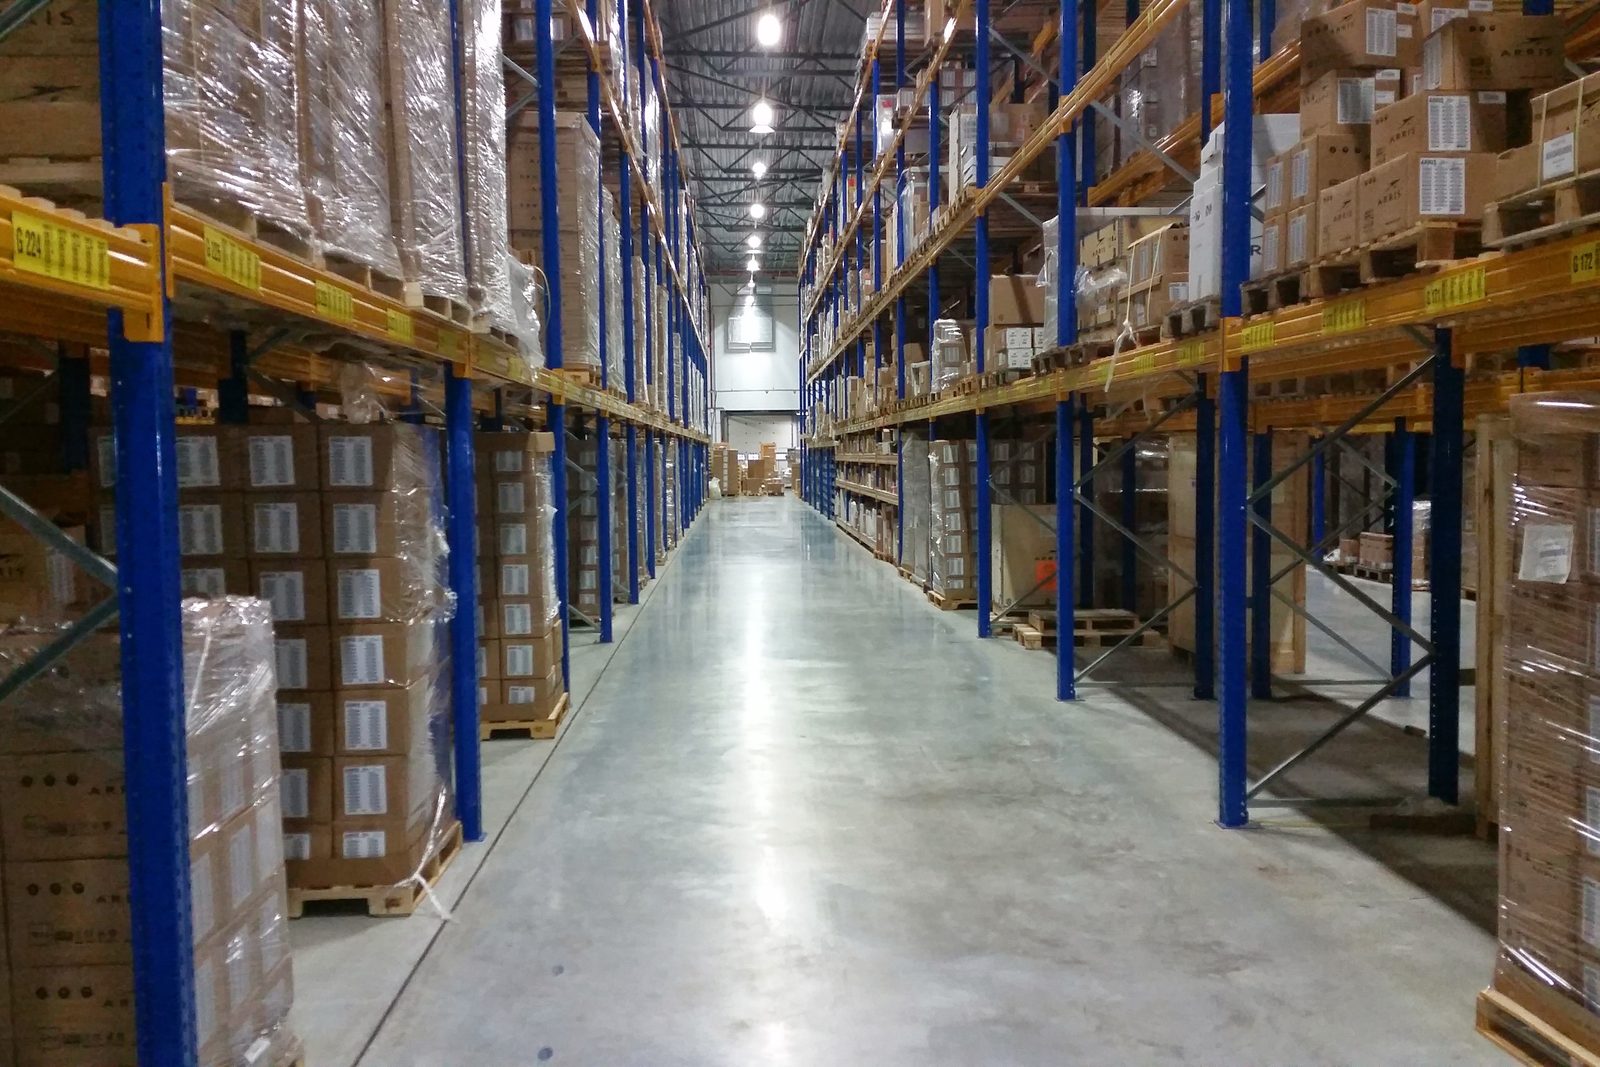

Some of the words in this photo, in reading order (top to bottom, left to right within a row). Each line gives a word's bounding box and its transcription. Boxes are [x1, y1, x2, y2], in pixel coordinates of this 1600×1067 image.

[1377, 190, 1402, 207] ARRIS
[16, 227, 23, 254] G
[25, 230, 42, 258] 224
[1573, 255, 1579, 273] G
[1581, 252, 1593, 271] 172
